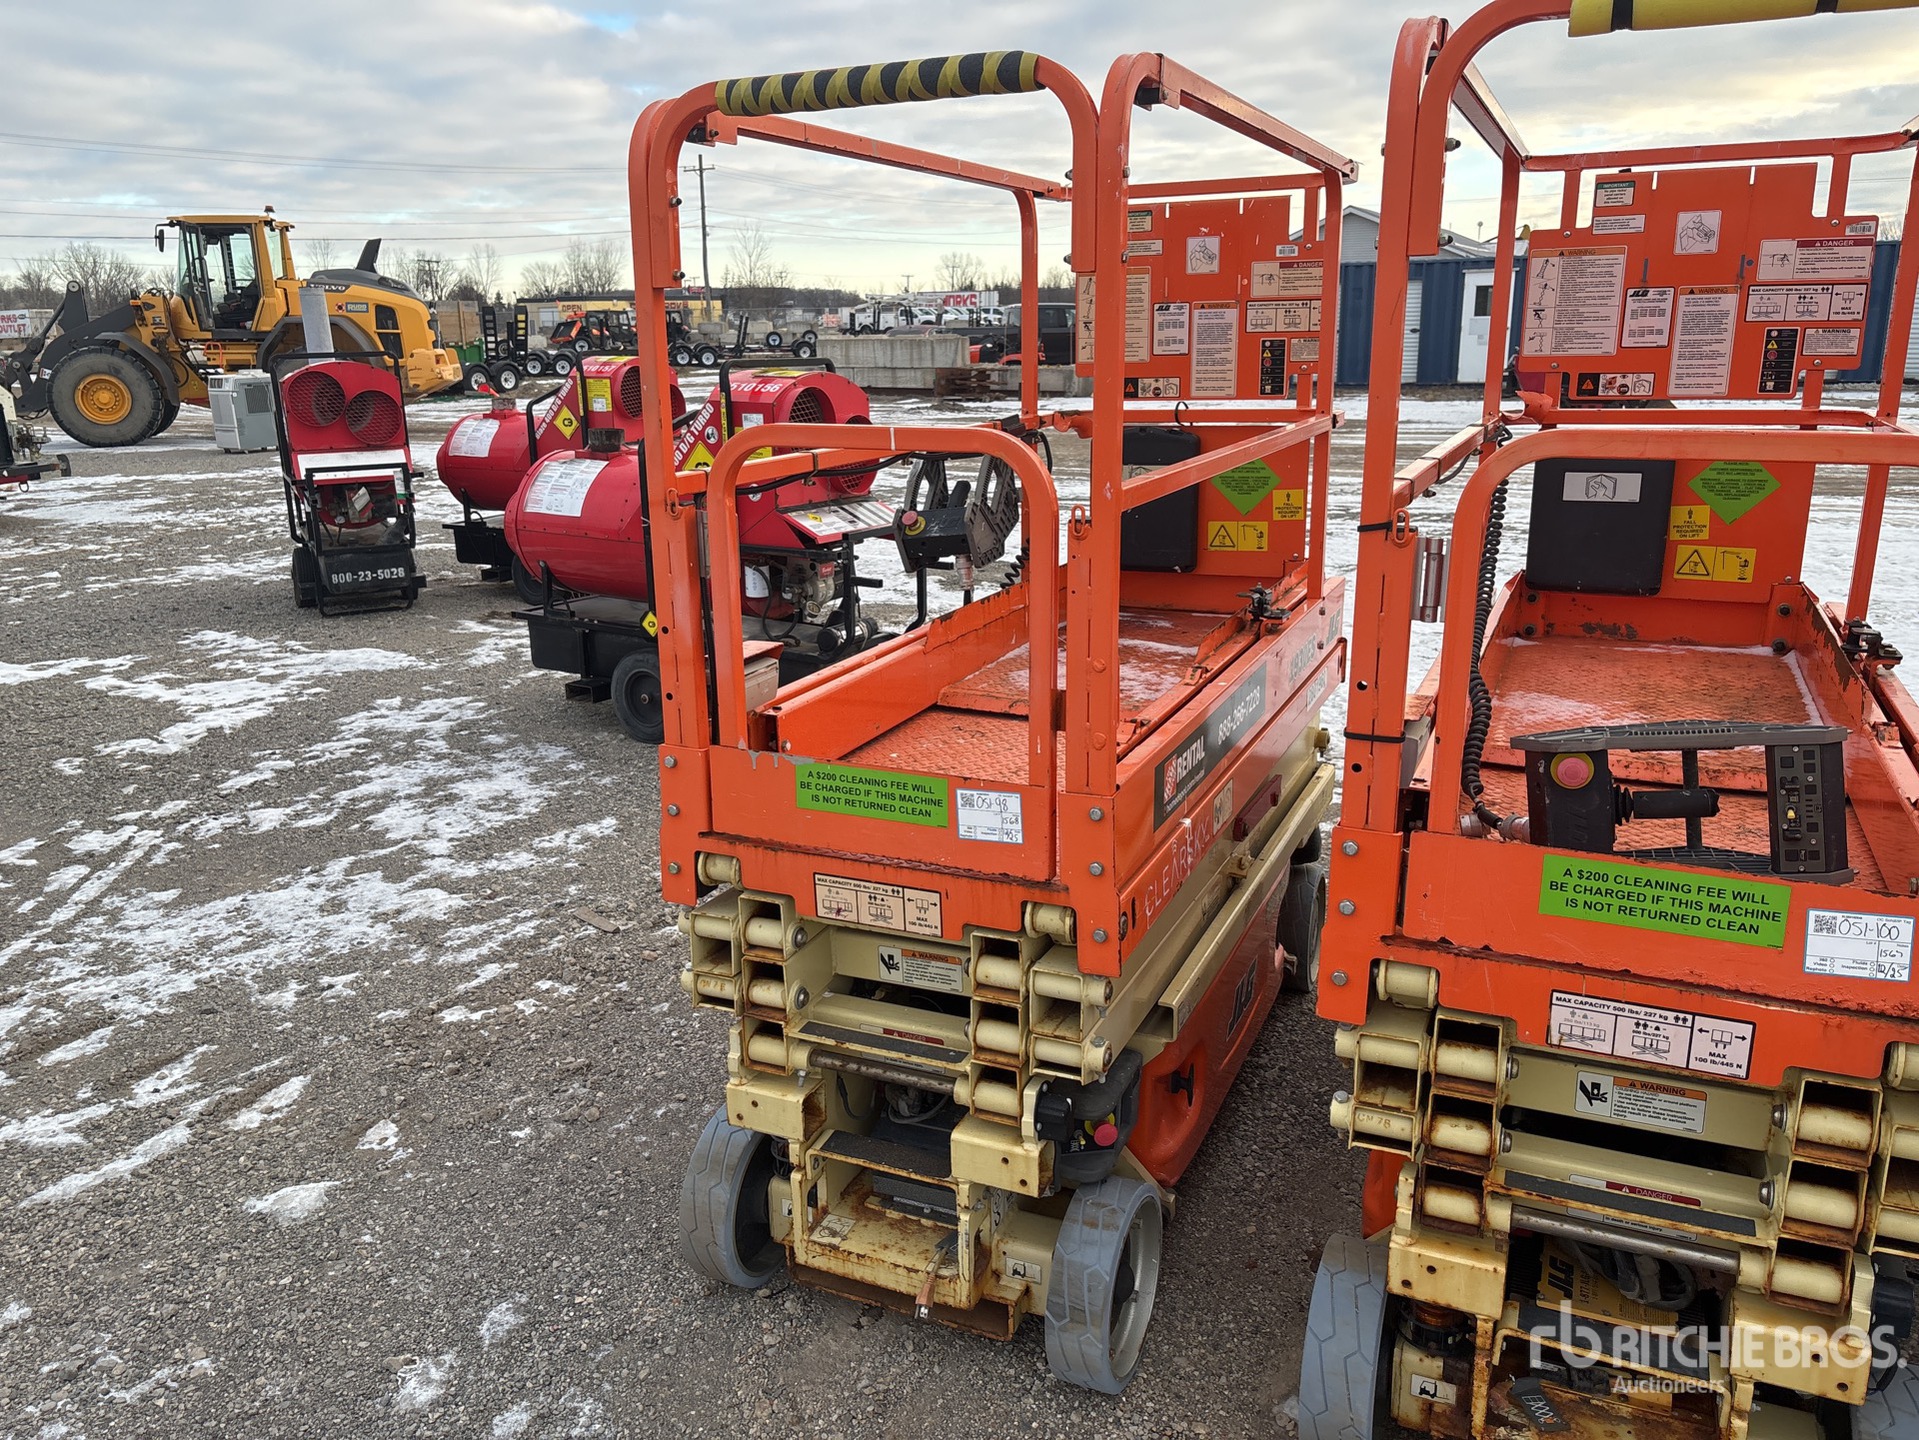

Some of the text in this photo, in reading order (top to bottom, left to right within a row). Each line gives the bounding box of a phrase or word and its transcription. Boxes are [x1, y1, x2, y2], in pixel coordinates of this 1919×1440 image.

[1629, 290, 1650, 298] JLG
[562, 304, 582, 312] OPEN
[1156, 304, 1172, 312] JLG
[558, 378, 574, 402] TURBO
[730, 382, 783, 393] 510156
[680, 432, 696, 454] D/G
[690, 402, 715, 437] TURBO
[331, 567, 406, 584] 800-23-5028
[1177, 735, 1206, 784] RENTAL
[807, 771, 936, 795] A $200 CLEANING FEE WILL
[800, 781, 944, 809] BE CHARGED IF THIS MACHINE
[811, 793, 932, 818] IS NOT RETURNED CLEAN
[1563, 868, 1770, 906] A $200 CLEANING FEE WILL
[1549, 881, 1782, 923] BE CHARGED IF THIS MACHINE
[1565, 897, 1760, 935] IS NOT RETURNED CLEAN
[1555, 996, 1572, 1004] MAX
[1574, 999, 1611, 1010] CAPACITY
[1627, 1008, 1642, 1016] lbs/
[1659, 1013, 1669, 1021] kg
[1694, 1056, 1708, 1064] 100
[1710, 1059, 1734, 1068] lb/445
[1709, 1051, 1727, 1060] MAX
[1640, 1081, 1686, 1096] WARNING
[1667, 1112, 1696, 1121] instructions
[1636, 1188, 1673, 1201] DANGER
